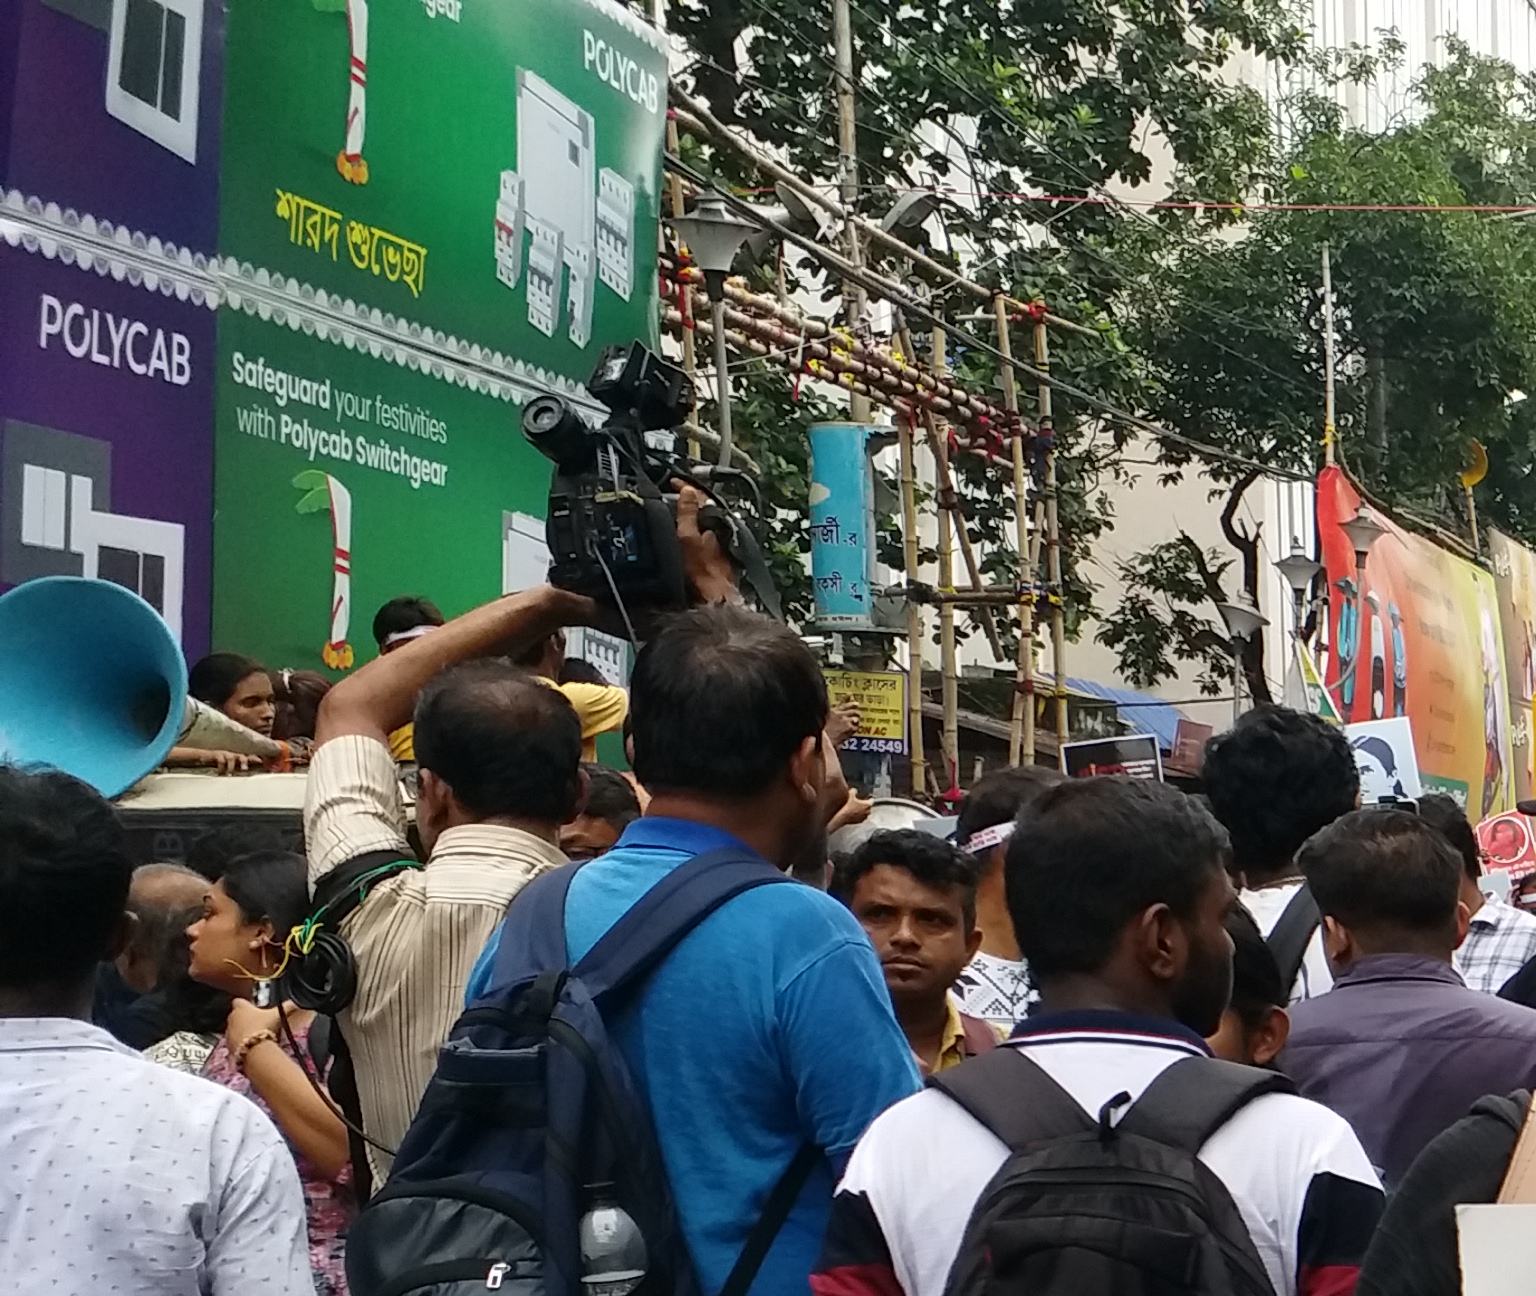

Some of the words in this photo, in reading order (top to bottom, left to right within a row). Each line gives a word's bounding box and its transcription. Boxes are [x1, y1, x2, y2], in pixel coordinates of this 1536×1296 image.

[583, 29, 658, 115] POLYCAB
[275, 187, 342, 261] শারদ
[40, 293, 191, 386] POLYCAB
[232, 351, 330, 410] Safeguard
[334, 388, 371, 423] your
[375, 394, 448, 444] festivities
[236, 403, 276, 440] with
[280, 413, 352, 461] Polycab
[355, 435, 448, 489] Switchgear
[861, 739, 903, 754] 24549
